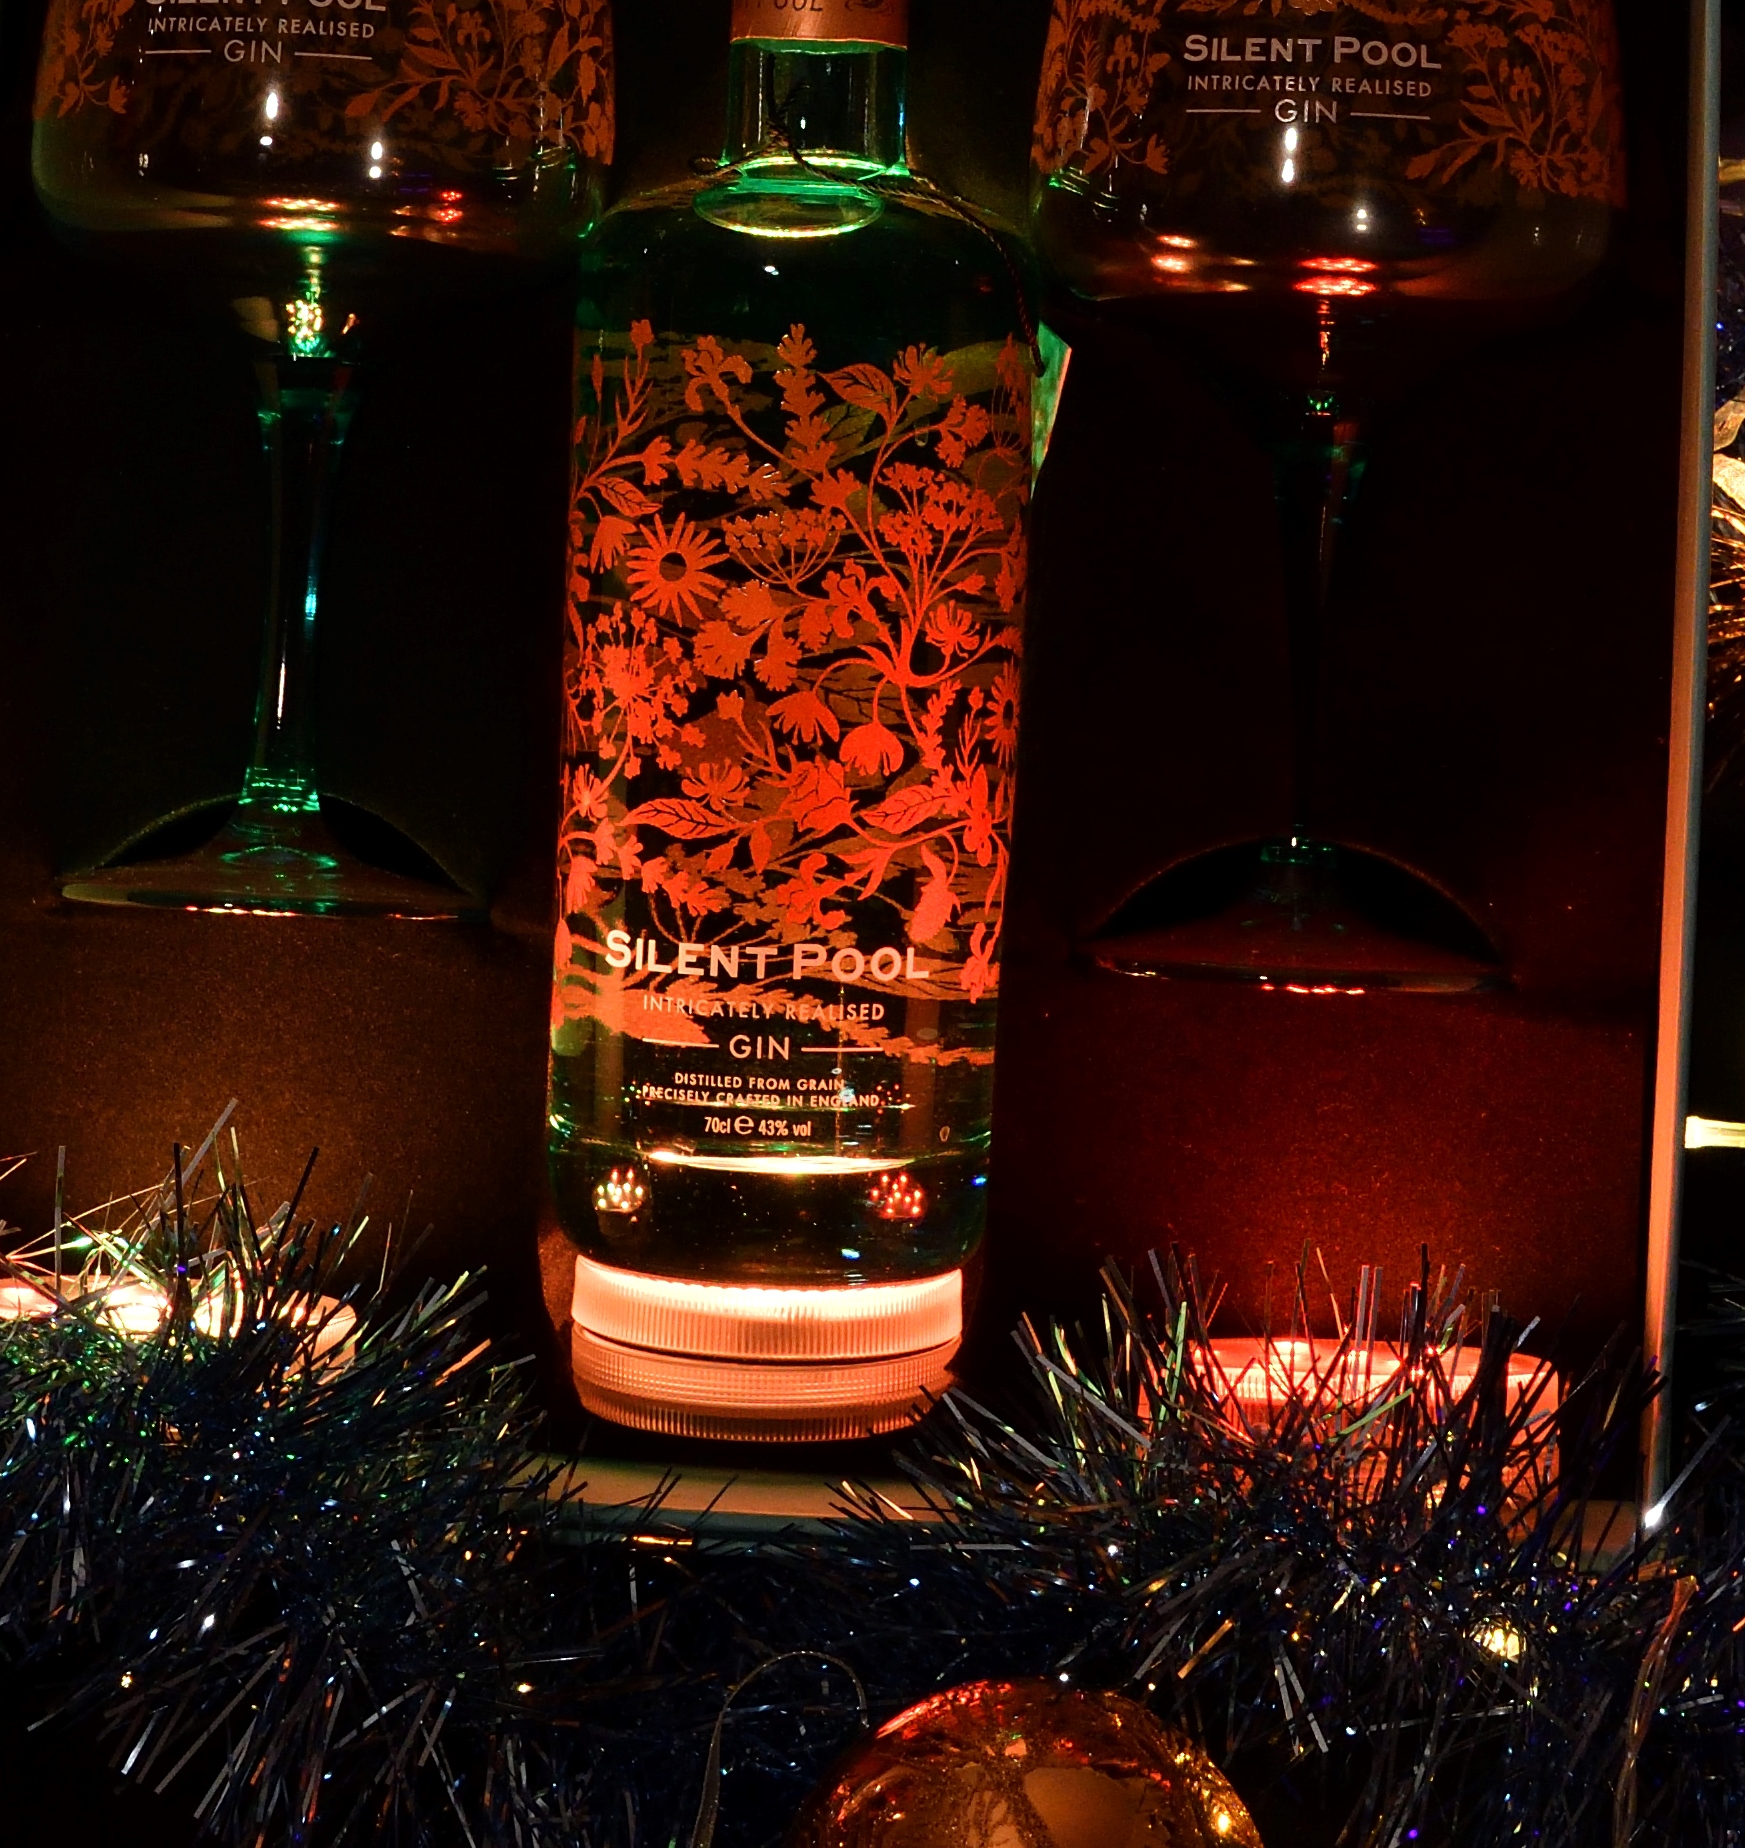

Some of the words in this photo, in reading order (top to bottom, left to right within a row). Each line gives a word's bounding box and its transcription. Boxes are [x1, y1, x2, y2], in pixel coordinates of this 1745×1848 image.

[148, 17, 267, 33] INTRICATELY
[278, 19, 374, 39] REALISED
[224, 40, 282, 63] GIN
[1183, 34, 1322, 62] SILENT
[1333, 37, 1442, 69] POOL
[1188, 75, 1320, 92] INTRICATELY
[1332, 77, 1432, 97] REALISED
[1275, 99, 1337, 123] GIN
[605, 930, 776, 979] SILENT
[793, 944, 930, 981] POOL
[642, 995, 773, 1020] INTRICATELY
[785, 1002, 884, 1021] REALISED
[729, 1035, 790, 1060] GIN
[674, 1072, 742, 1089] DISTILLED
[748, 1077, 791, 1090] FROM
[796, 1077, 845, 1091] GRAIN
[642, 1085, 709, 1103] PRECISELY
[716, 1092, 780, 1107] CRAFTED
[787, 1093, 803, 1107] IN
[704, 1117, 731, 1134] 70cl
[758, 1120, 788, 1136] 43%
[793, 1120, 811, 1137] vol
